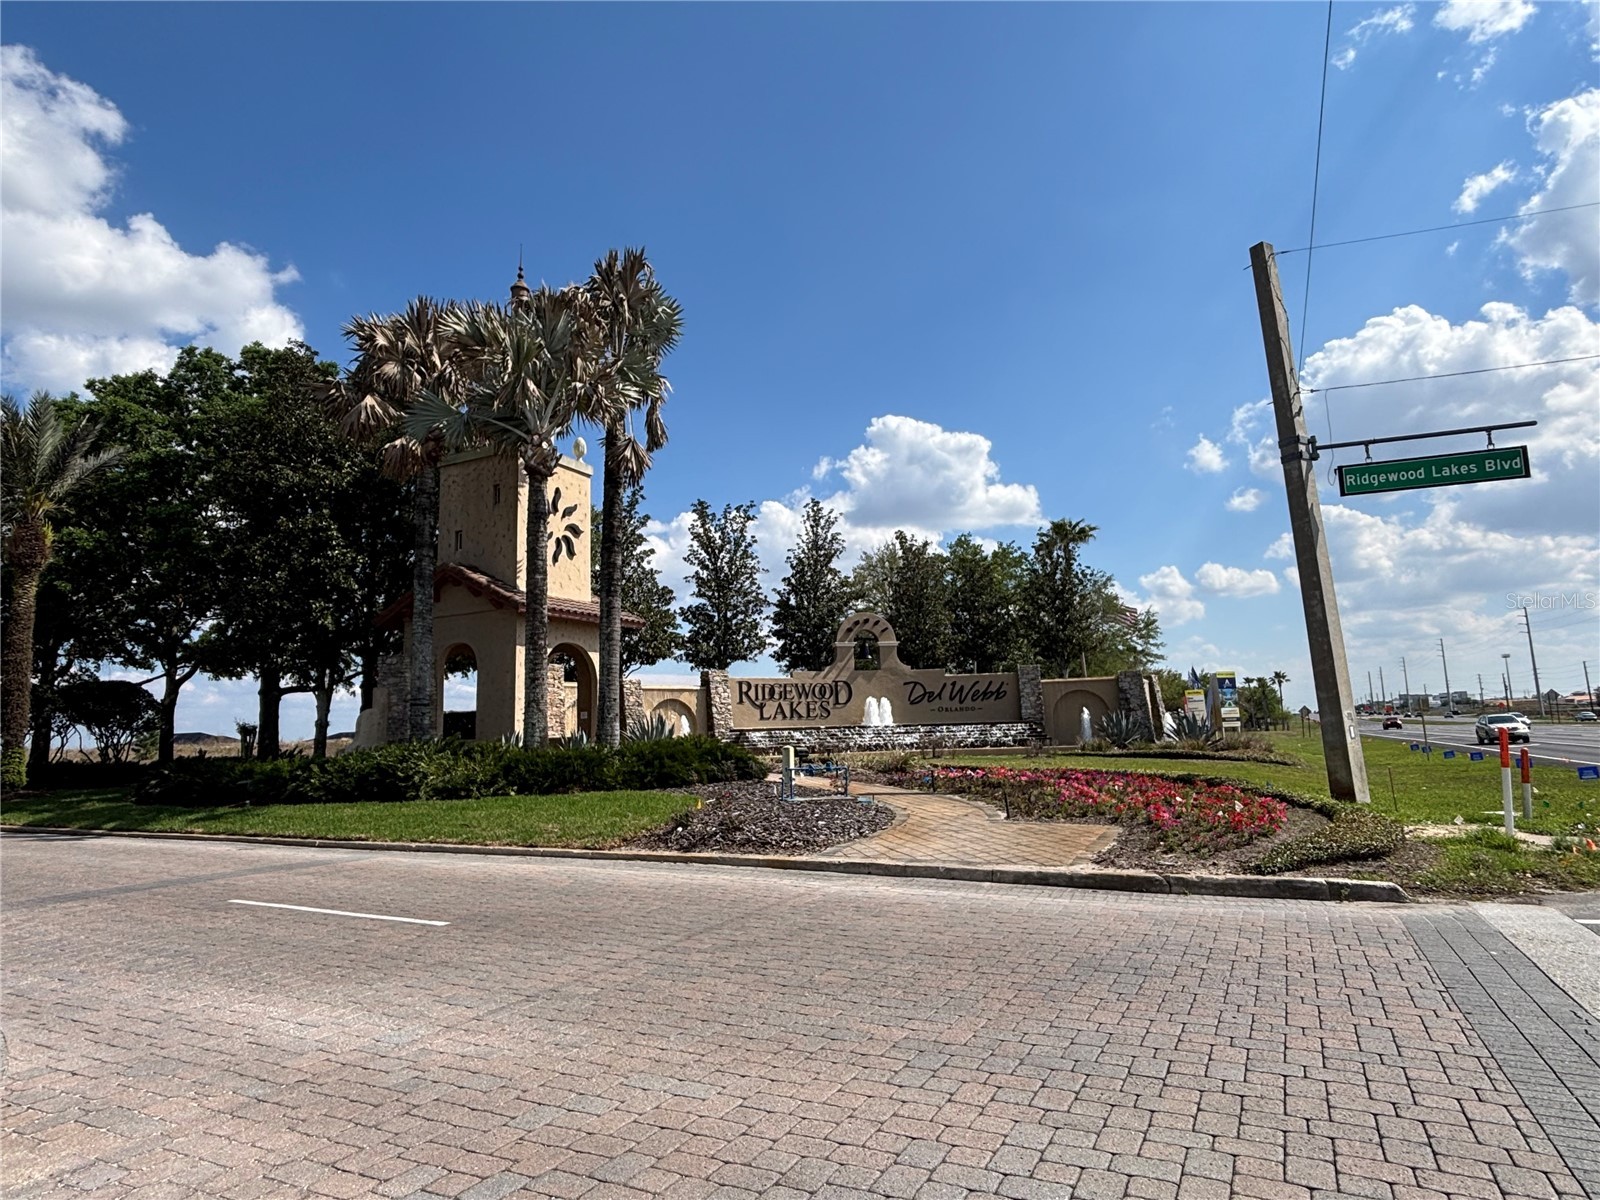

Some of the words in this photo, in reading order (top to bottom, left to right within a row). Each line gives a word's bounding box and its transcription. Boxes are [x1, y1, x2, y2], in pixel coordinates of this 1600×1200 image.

[1346, 467, 1425, 487] Ridgewood
[1432, 464, 1478, 477] Lakes
[1485, 457, 1521, 472] Blvd
[736, 680, 853, 709] RIDGEWOOD
[903, 681, 947, 705] Del
[949, 680, 1007, 704] Webb
[759, 700, 831, 720] LAKES
